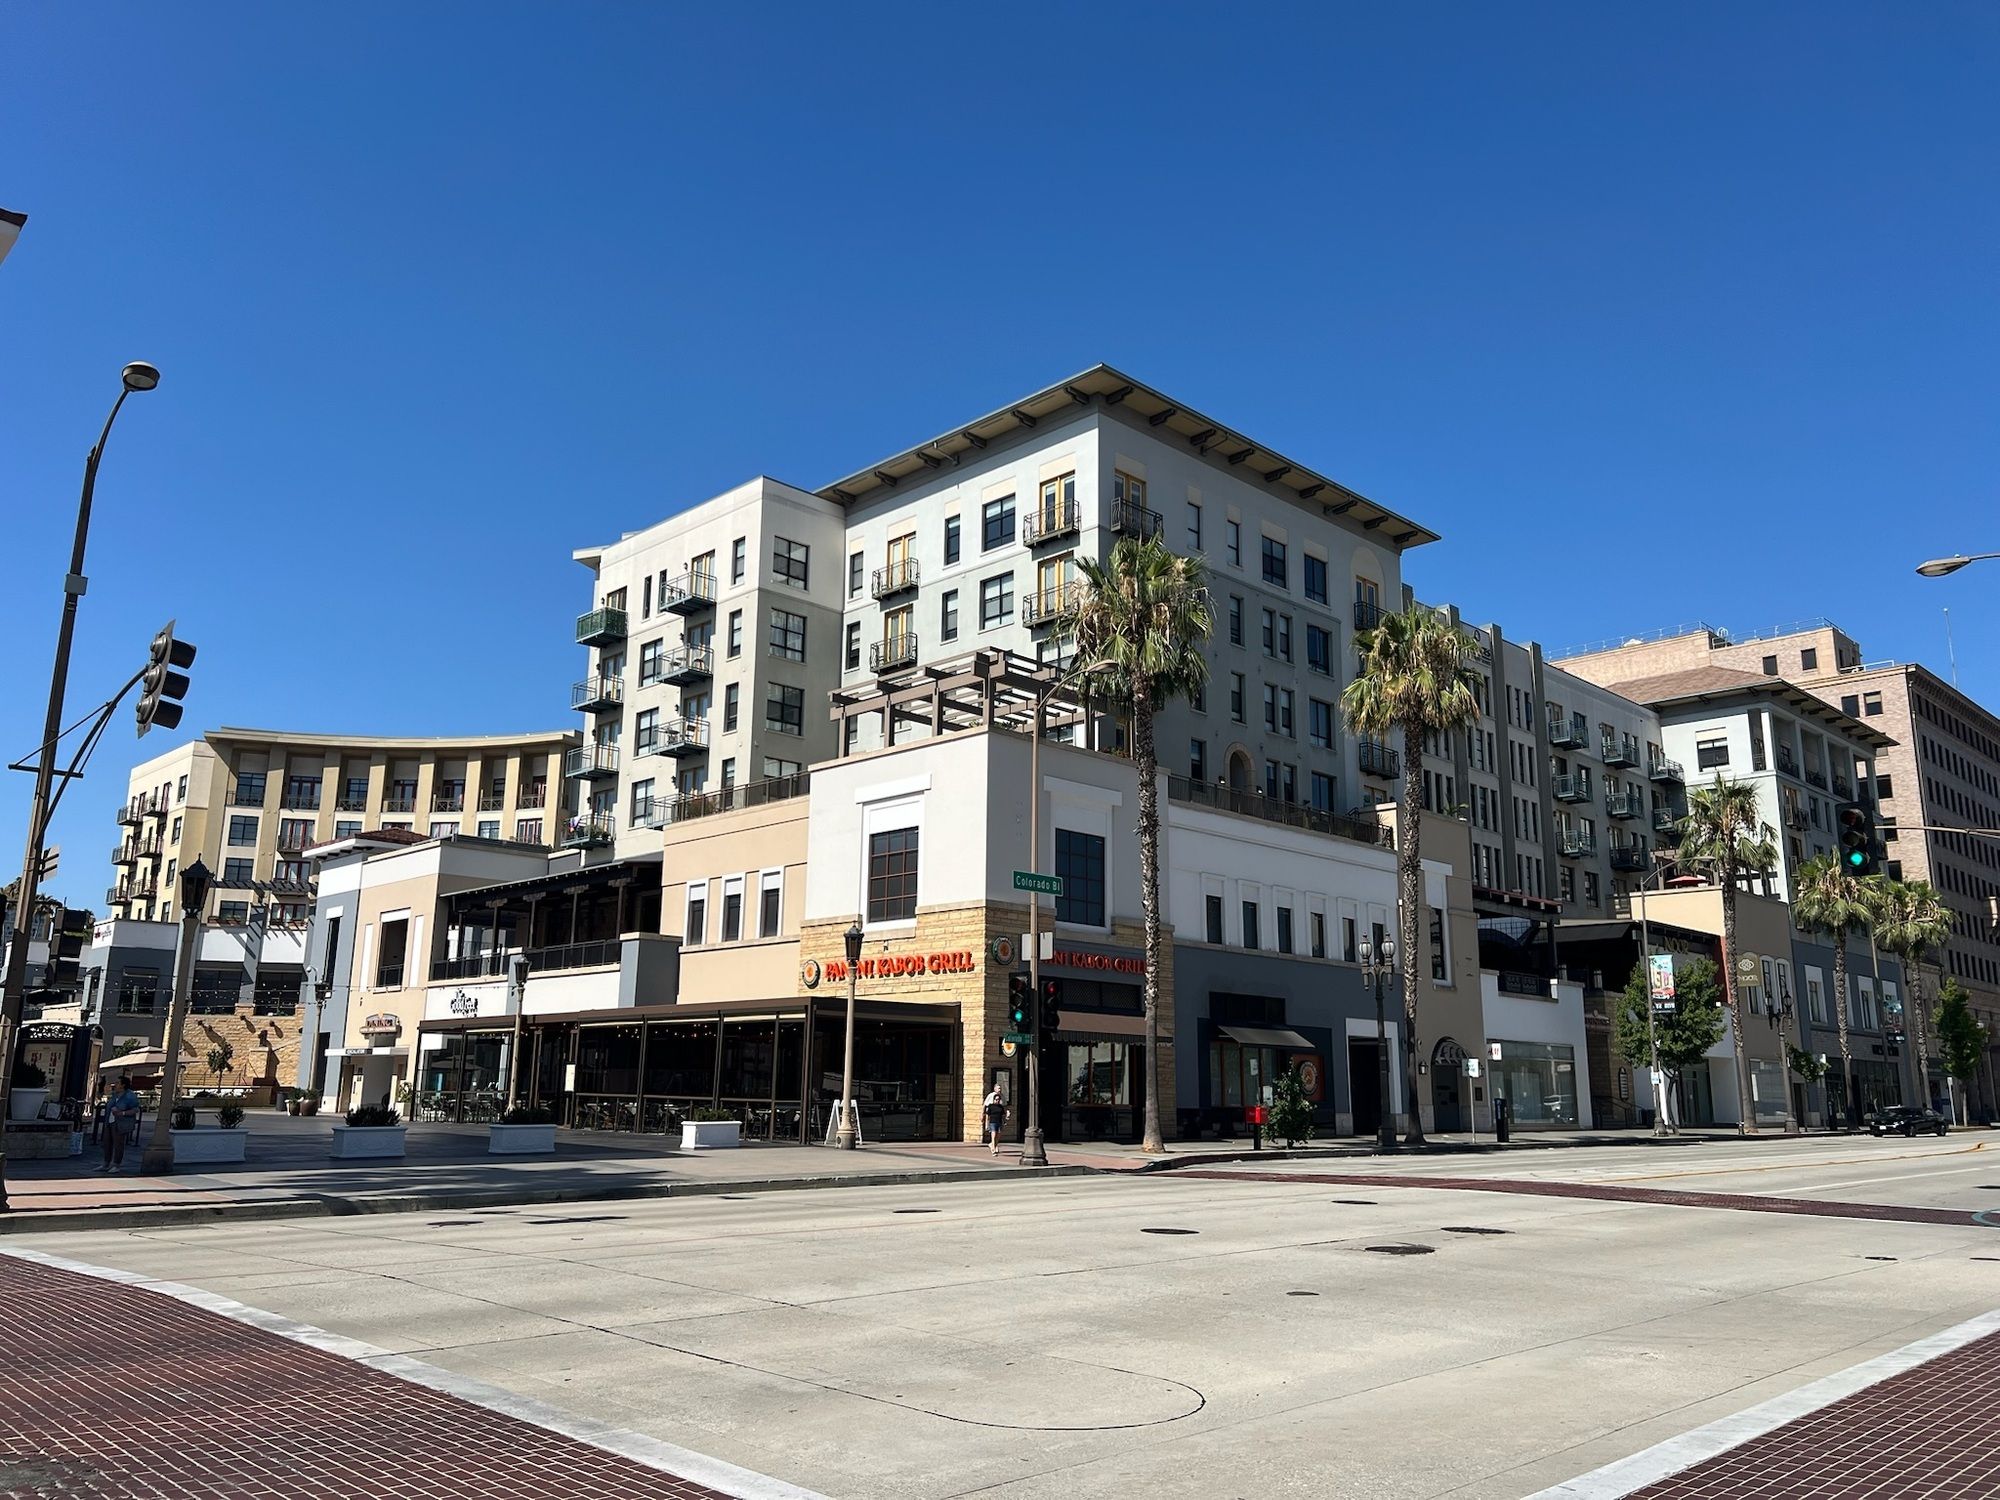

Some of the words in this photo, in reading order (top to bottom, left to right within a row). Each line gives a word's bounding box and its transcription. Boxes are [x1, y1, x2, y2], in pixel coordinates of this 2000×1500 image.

[1015, 875, 1050, 890] Colorado
[1052, 881, 1061, 891] Bl
[825, 959, 874, 978] PANNI
[876, 954, 925, 975] KABOB
[927, 950, 975, 972] GRILL
[1072, 952, 1112, 970] KABOB
